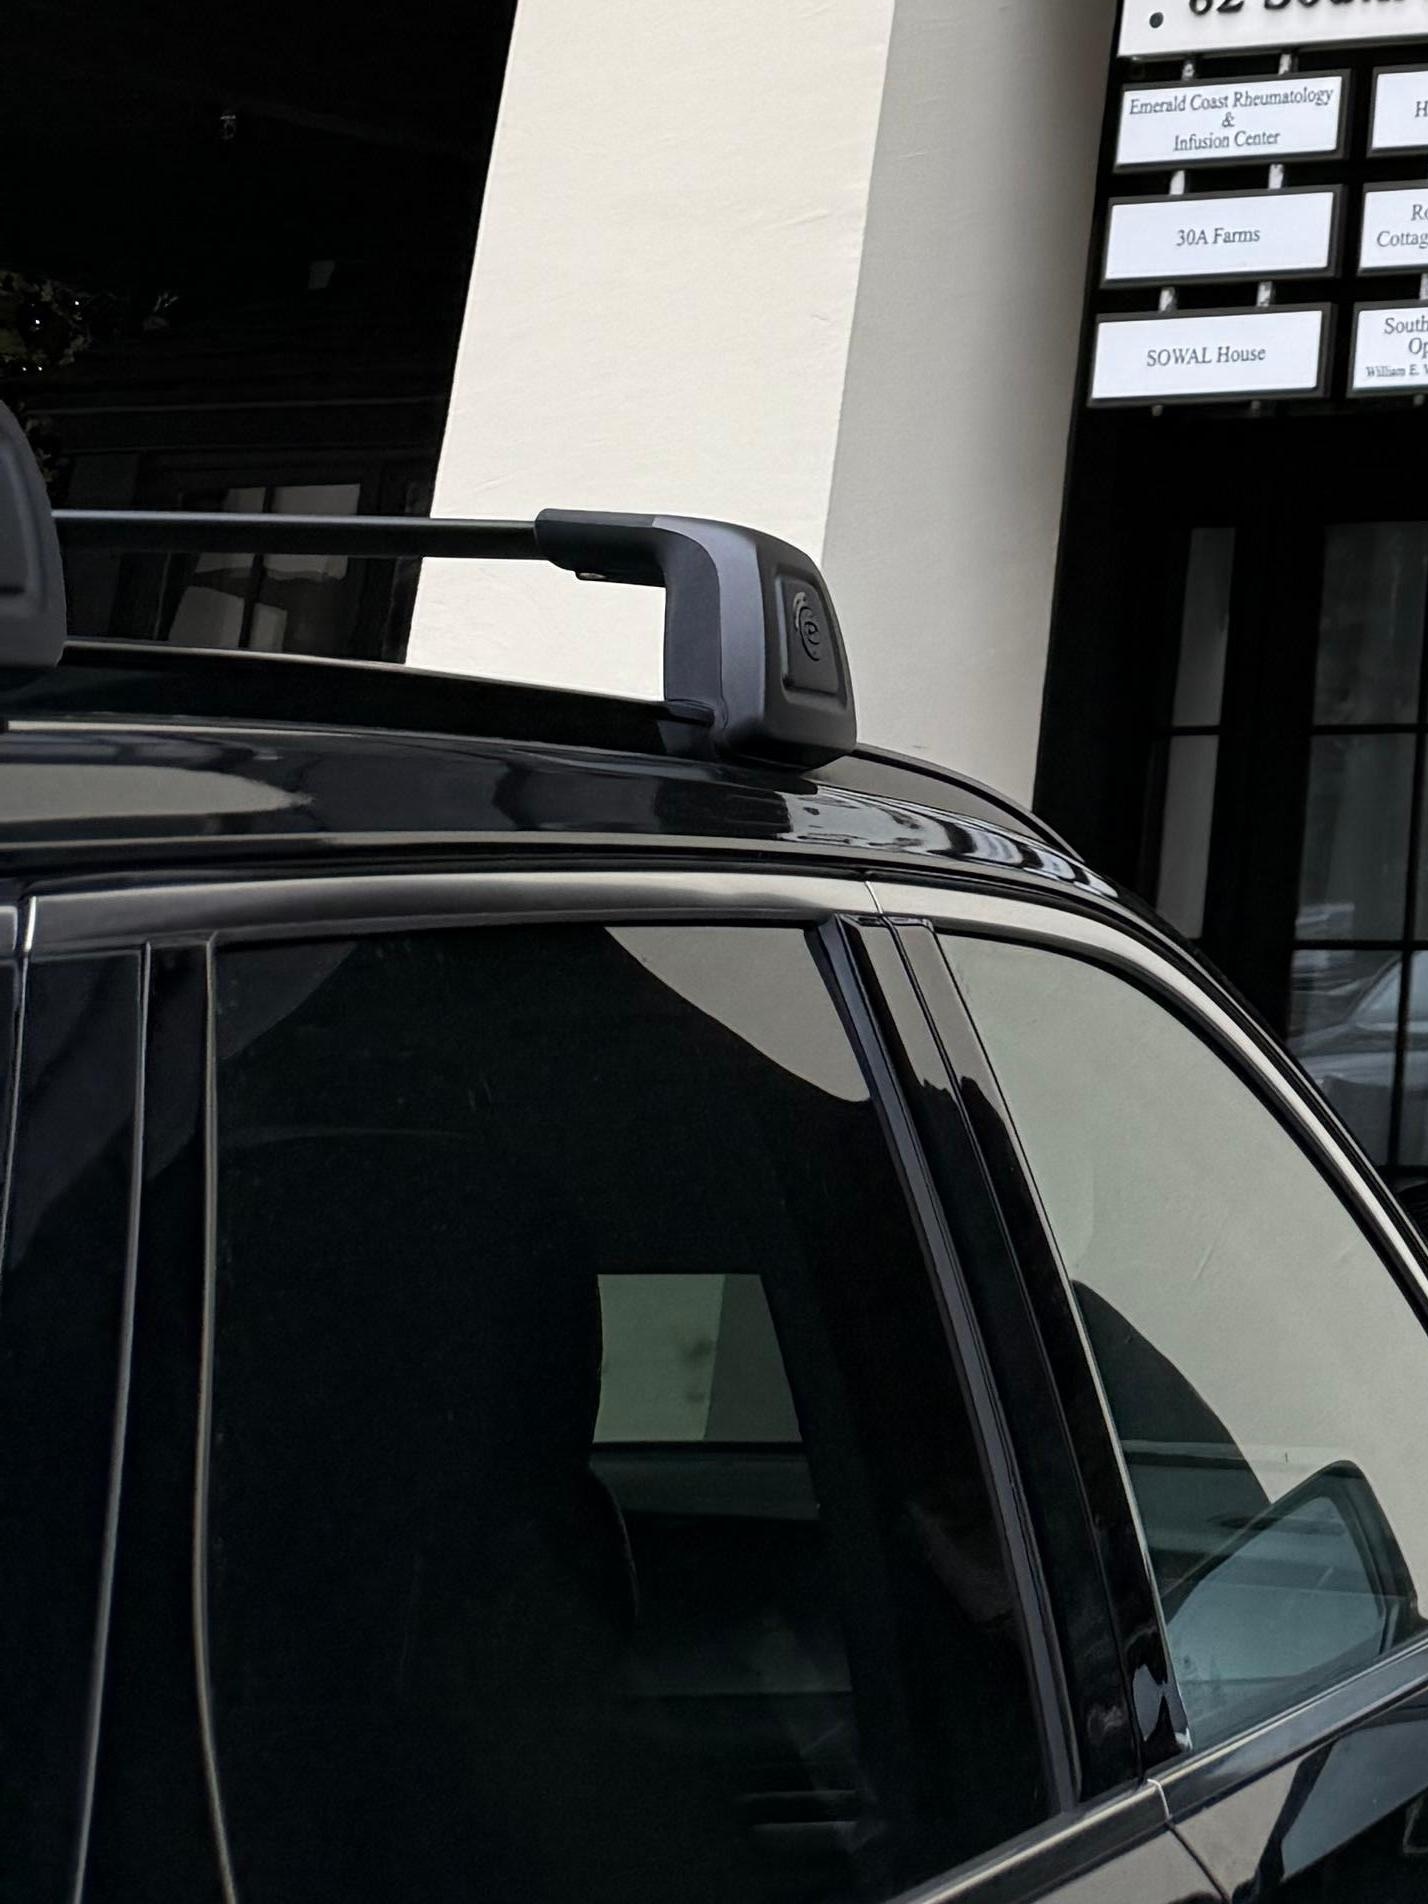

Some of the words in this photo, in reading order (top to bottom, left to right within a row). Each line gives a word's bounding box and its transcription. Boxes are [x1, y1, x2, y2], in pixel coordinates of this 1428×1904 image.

[1129, 96, 1186, 115] Emerald
[1190, 92, 1230, 108] Coast
[1233, 86, 1334, 108] Rheumatology
[1222, 112, 1236, 128] &
[1173, 132, 1230, 152] Infusion
[1235, 130, 1280, 147] Center
[1176, 229, 1209, 246] 30A
[1213, 227, 1261, 244] Farms
[1146, 348, 1213, 367] SOWAL
[1216, 345, 1266, 363] House
